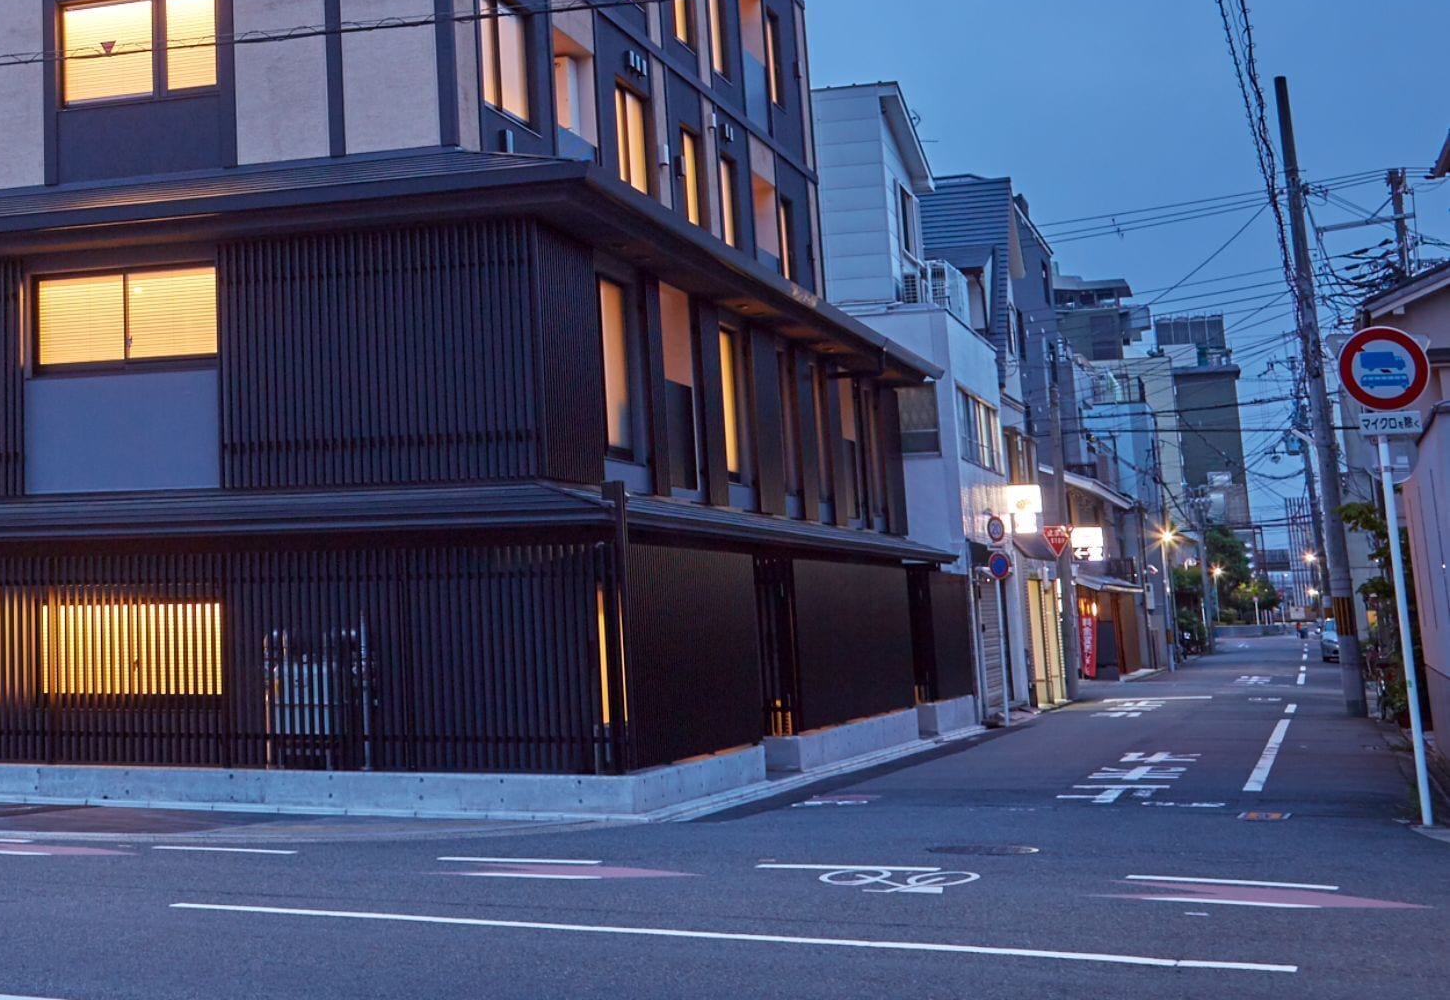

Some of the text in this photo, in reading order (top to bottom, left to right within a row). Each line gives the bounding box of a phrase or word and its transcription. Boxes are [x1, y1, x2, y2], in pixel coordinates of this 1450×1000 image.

[1362, 416, 1420, 430] マイクロを除く
